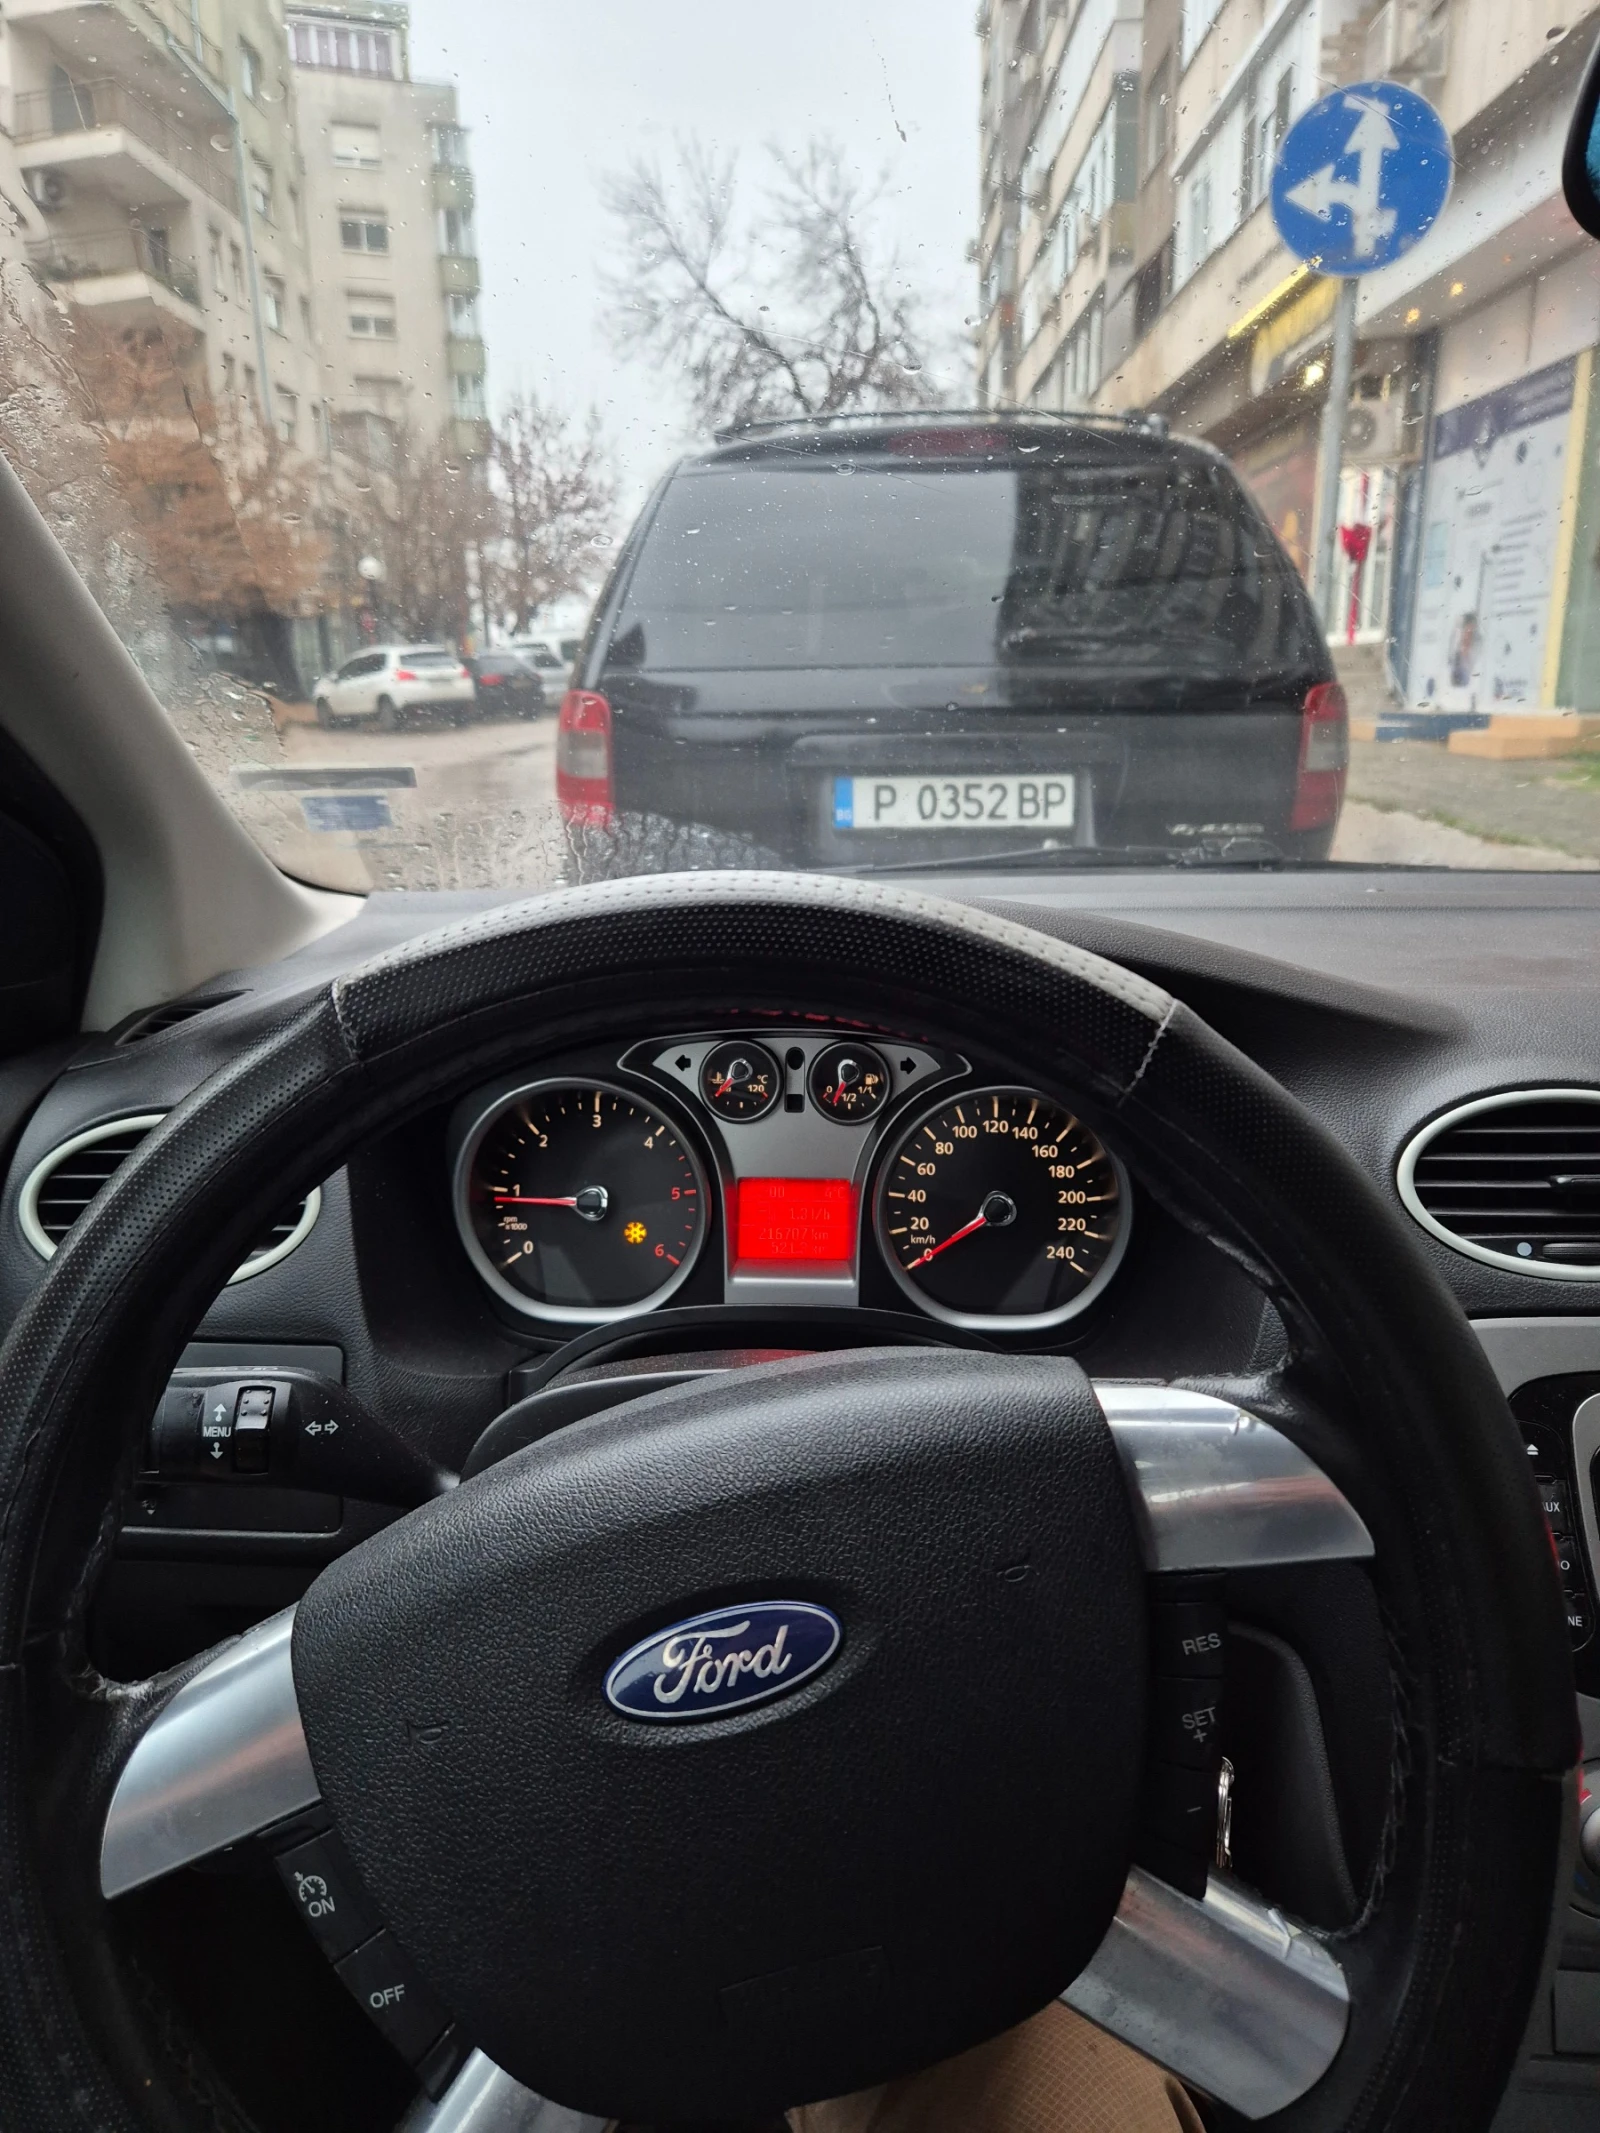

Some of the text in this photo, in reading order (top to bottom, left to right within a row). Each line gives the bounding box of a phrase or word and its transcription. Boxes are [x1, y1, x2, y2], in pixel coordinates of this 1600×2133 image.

[875, 783, 1066, 820] P 0352 BP
[747, 1084, 765, 1093] 120
[841, 1093, 857, 1102] 1/2
[592, 1114, 602, 1128] 3
[982, 1120, 1009, 1133] 120
[952, 1125, 978, 1138] 100
[1012, 1126, 1038, 1139] 140
[539, 1134, 548, 1148] 2
[643, 1136, 654, 1149] 4
[935, 1141, 954, 1154] 80
[1031, 1144, 1058, 1158] 160
[917, 1162, 936, 1176] 60
[1048, 1165, 1075, 1178] 180
[512, 1183, 520, 1197] 1
[671, 1187, 680, 1200] 5
[907, 1189, 926, 1203] 40
[1058, 1190, 1086, 1204] 200
[910, 1216, 929, 1230] 20
[1058, 1217, 1086, 1231] 220
[910, 1234, 936, 1244] km/h
[523, 1240, 534, 1254] 0
[654, 1243, 664, 1256] 6
[1046, 1245, 1075, 1259] 240
[202, 1426, 232, 1438] MENU
[1181, 1633, 1222, 1655] RES
[653, 1620, 793, 1704] Ford
[1181, 1706, 1216, 1730] SET
[308, 1896, 336, 1917] ON
[369, 1984, 405, 2008] OFF
